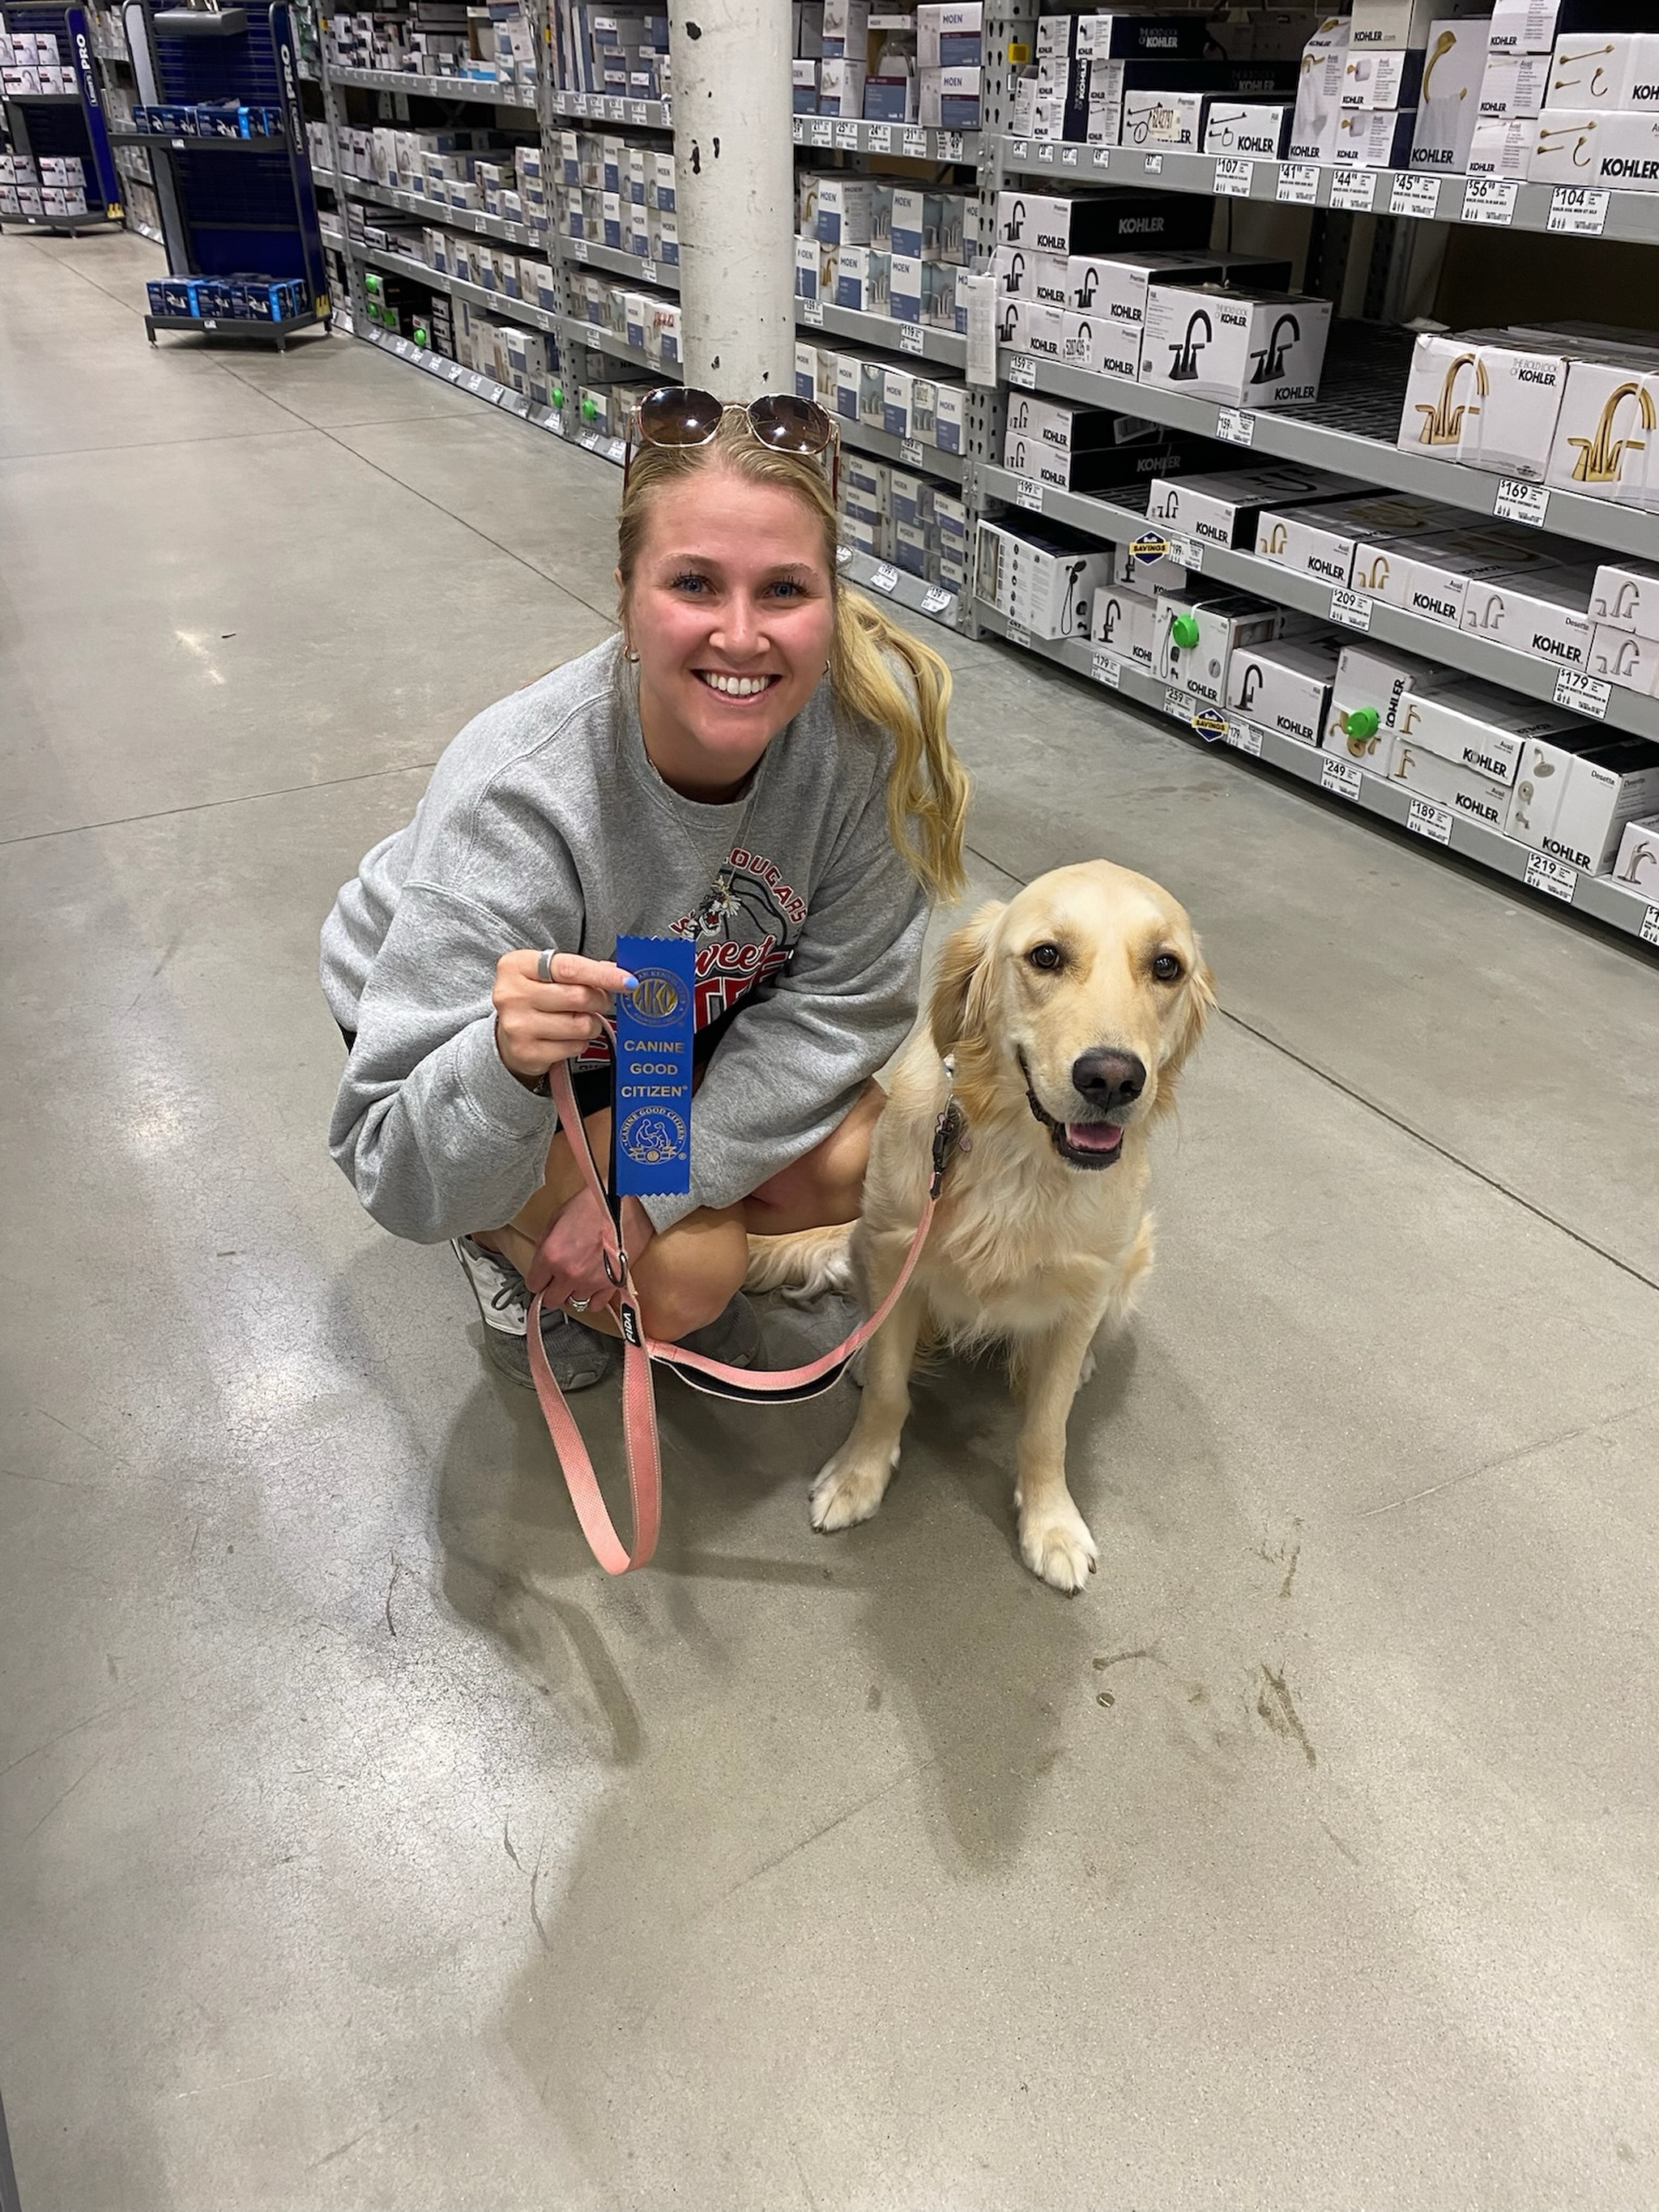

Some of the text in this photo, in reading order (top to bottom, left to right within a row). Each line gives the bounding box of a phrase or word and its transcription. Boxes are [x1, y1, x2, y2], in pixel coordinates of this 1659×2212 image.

[943, 14, 962, 23] MOEN
[1146, 36, 1178, 48] KOHLER
[1491, 36, 1517, 45] KOHLER
[77, 34, 91, 69] PRO
[281, 45, 296, 99] PRO
[793, 70, 803, 79] OEN
[1079, 59, 1087, 94] KOHLE
[944, 78, 962, 86] MOEN
[1342, 96, 1363, 104] KOHLER
[1632, 85, 1659, 100] KOH
[1481, 102, 1507, 112] KOHLER
[1034, 127, 1048, 135] KOHLER
[1238, 135, 1273, 152] KOHLER
[1290, 145, 1320, 158] KOHLER
[1337, 150, 1358, 160] KOHLER
[1412, 147, 1454, 163] KOHLER
[1218, 159, 1238, 173] $107
[1469, 162, 1495, 173] KOHLER
[1601, 158, 1659, 179] KOHLER
[1335, 172, 1350, 185] $44
[1397, 174, 1412, 190] $45
[1469, 180, 1487, 196] $56
[821, 192, 836, 202] MOEN
[894, 196, 911, 207] MOEN
[1556, 188, 1584, 206] $104
[967, 206, 978, 217] MOE
[1119, 217, 1164, 233] KOHLER
[1037, 235, 1065, 249] KOHLER
[840, 257, 857, 267] MOEN
[893, 262, 910, 273] MOEN
[1037, 287, 1064, 302] KOHLER
[1111, 304, 1142, 322] KOHLER
[1220, 312, 1247, 326] KOHLER
[1030, 338, 1057, 355] KOHLER
[797, 356, 808, 364] MOEN
[1011, 356, 1026, 368] $159
[1103, 357, 1134, 375] KOHLER
[1514, 358, 1523, 366] THE
[839, 369, 852, 378] MOEN
[1519, 370, 1555, 386] KOHLER
[886, 386, 902, 396] MOEN
[1274, 386, 1315, 400] KOHLER
[940, 401, 955, 411] MOEN
[1043, 428, 1067, 446] KOHLER
[1137, 457, 1180, 471] KOHLER
[1040, 469, 1065, 486] KOHLER
[1502, 480, 1528, 498] $169
[1196, 522, 1228, 543] KOHLER
[1133, 543, 1166, 552] SAVINGS
[1308, 556, 1345, 581] KOHLER
[1334, 590, 1355, 606] $209
[1414, 593, 1456, 618] KOHLER
[1565, 617, 1589, 631] Desette
[1132, 646, 1152, 662] KOHL
[1533, 633, 1582, 664] KOHLER
[1561, 670, 1589, 689] $179
[1166, 687, 1184, 702] $259
[1187, 680, 1218, 701] KOHLER
[1196, 721, 1225, 731] SAVINGS
[1277, 716, 1313, 739] KOHLER
[1324, 760, 1346, 777] $249
[1463, 748, 1507, 778] KOHLER
[1591, 769, 1614, 786] Desette
[1412, 801, 1435, 819] $189
[1456, 793, 1499, 823] KOHLER
[1542, 836, 1591, 870] KOHLER
[1530, 855, 1557, 875] $219
[729, 847, 808, 924] OUGARS
[1648, 908, 1659, 922] $1
[695, 935, 777, 974] weet
[625, 1040, 684, 1054] CANINE
[630, 1063, 678, 1075] GOOD
[622, 1114, 638, 1142] CANINE
[667, 1112, 684, 1140] CITIZEN
[623, 1313, 635, 1343] FIDA
